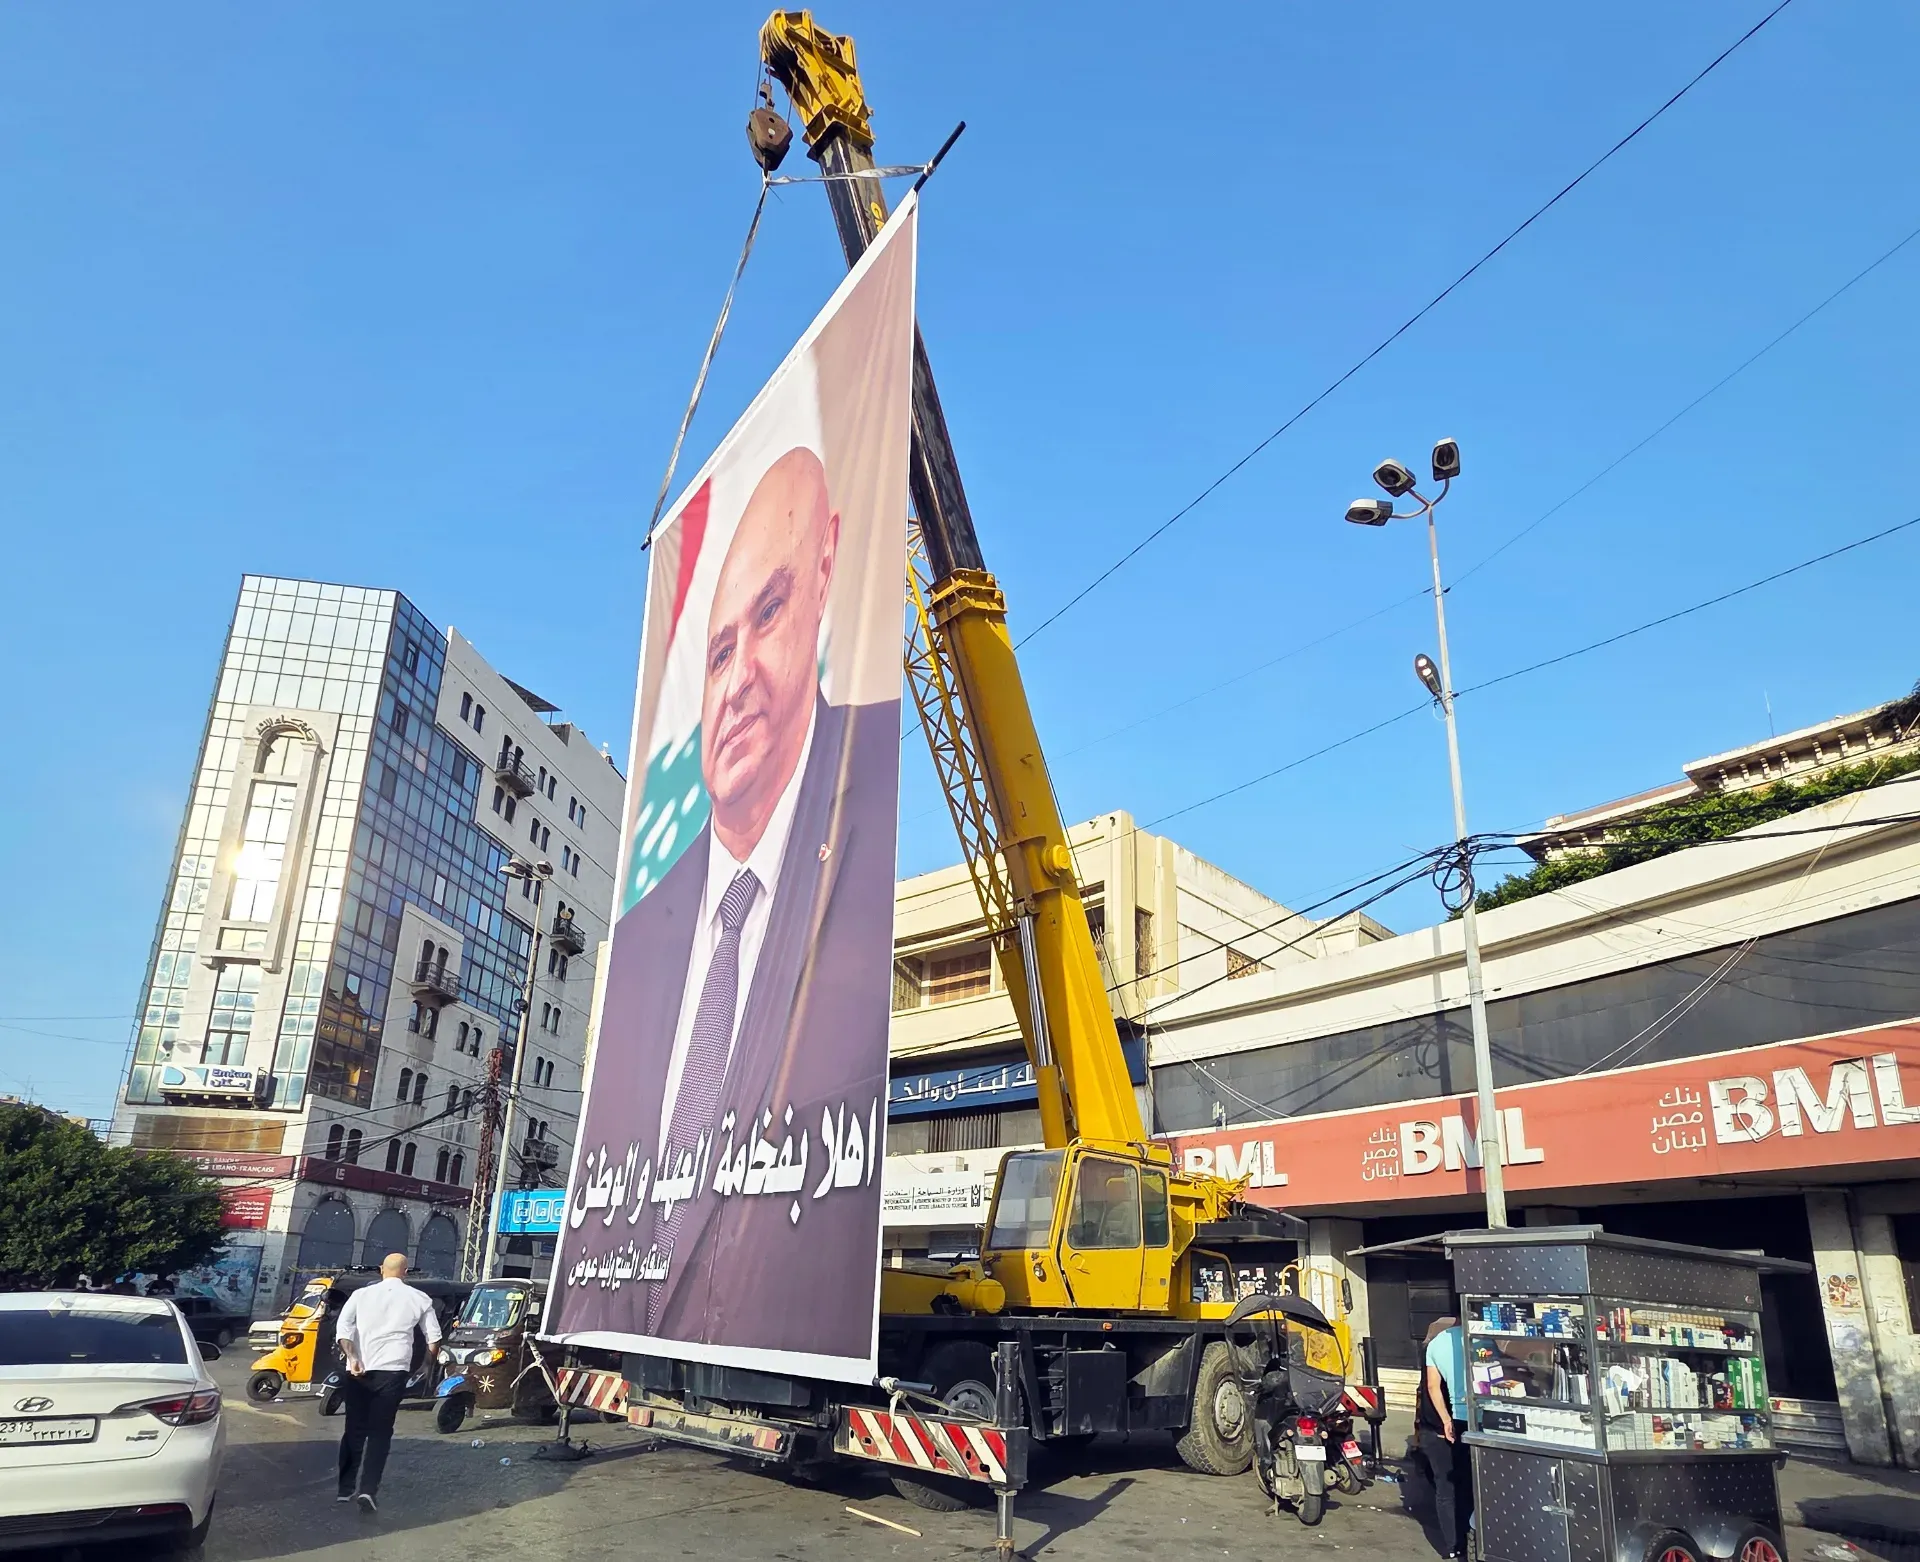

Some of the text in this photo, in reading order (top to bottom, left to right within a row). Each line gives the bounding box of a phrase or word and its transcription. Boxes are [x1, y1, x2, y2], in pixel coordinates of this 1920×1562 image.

[212, 1068, 252, 1079] Emkan
[944, 1067, 1008, 1101] لبنان
[1659, 1087, 1701, 1108] بنك
[1708, 1052, 1920, 1145] BML
[1368, 1128, 1398, 1144] بنك
[1651, 1112, 1704, 1133] مصر
[812, 1096, 878, 1199] اهلا
[1400, 1107, 1545, 1176] BML
[1652, 1127, 1707, 1154] لبنان
[712, 1103, 809, 1225] بفخامة
[1184, 1140, 1288, 1188] BML
[1362, 1147, 1399, 1165] مصر
[650, 1127, 714, 1222] العهد
[1362, 1160, 1400, 1181] لبنان
[917, 1186, 944, 1197] السياحة
